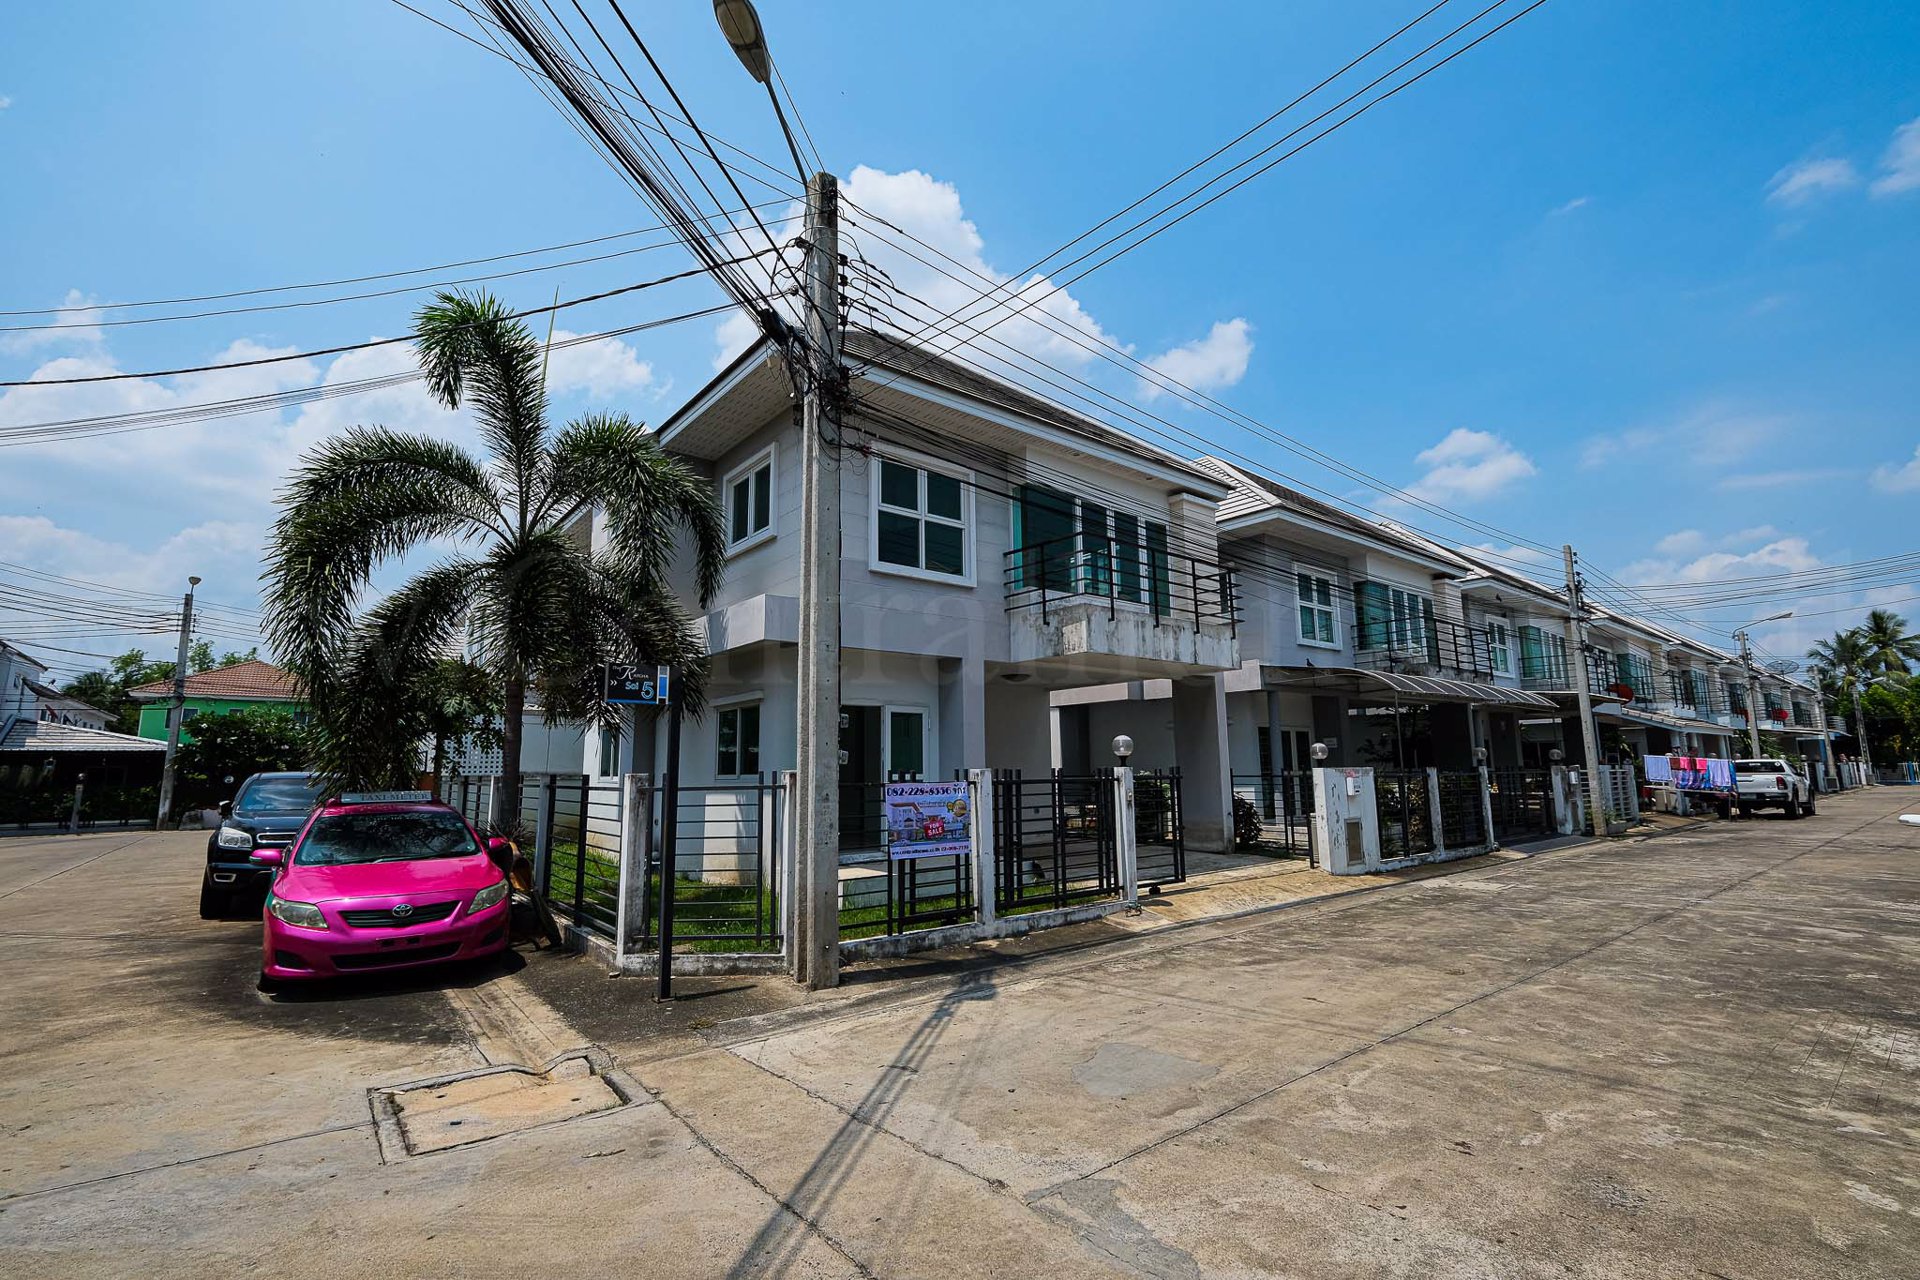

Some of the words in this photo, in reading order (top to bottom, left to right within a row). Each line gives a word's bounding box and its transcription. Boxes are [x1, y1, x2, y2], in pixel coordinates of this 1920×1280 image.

[641, 681, 655, 700] 5
[359, 793, 430, 801] TAXI-METER
[928, 827, 943, 836] SALE
